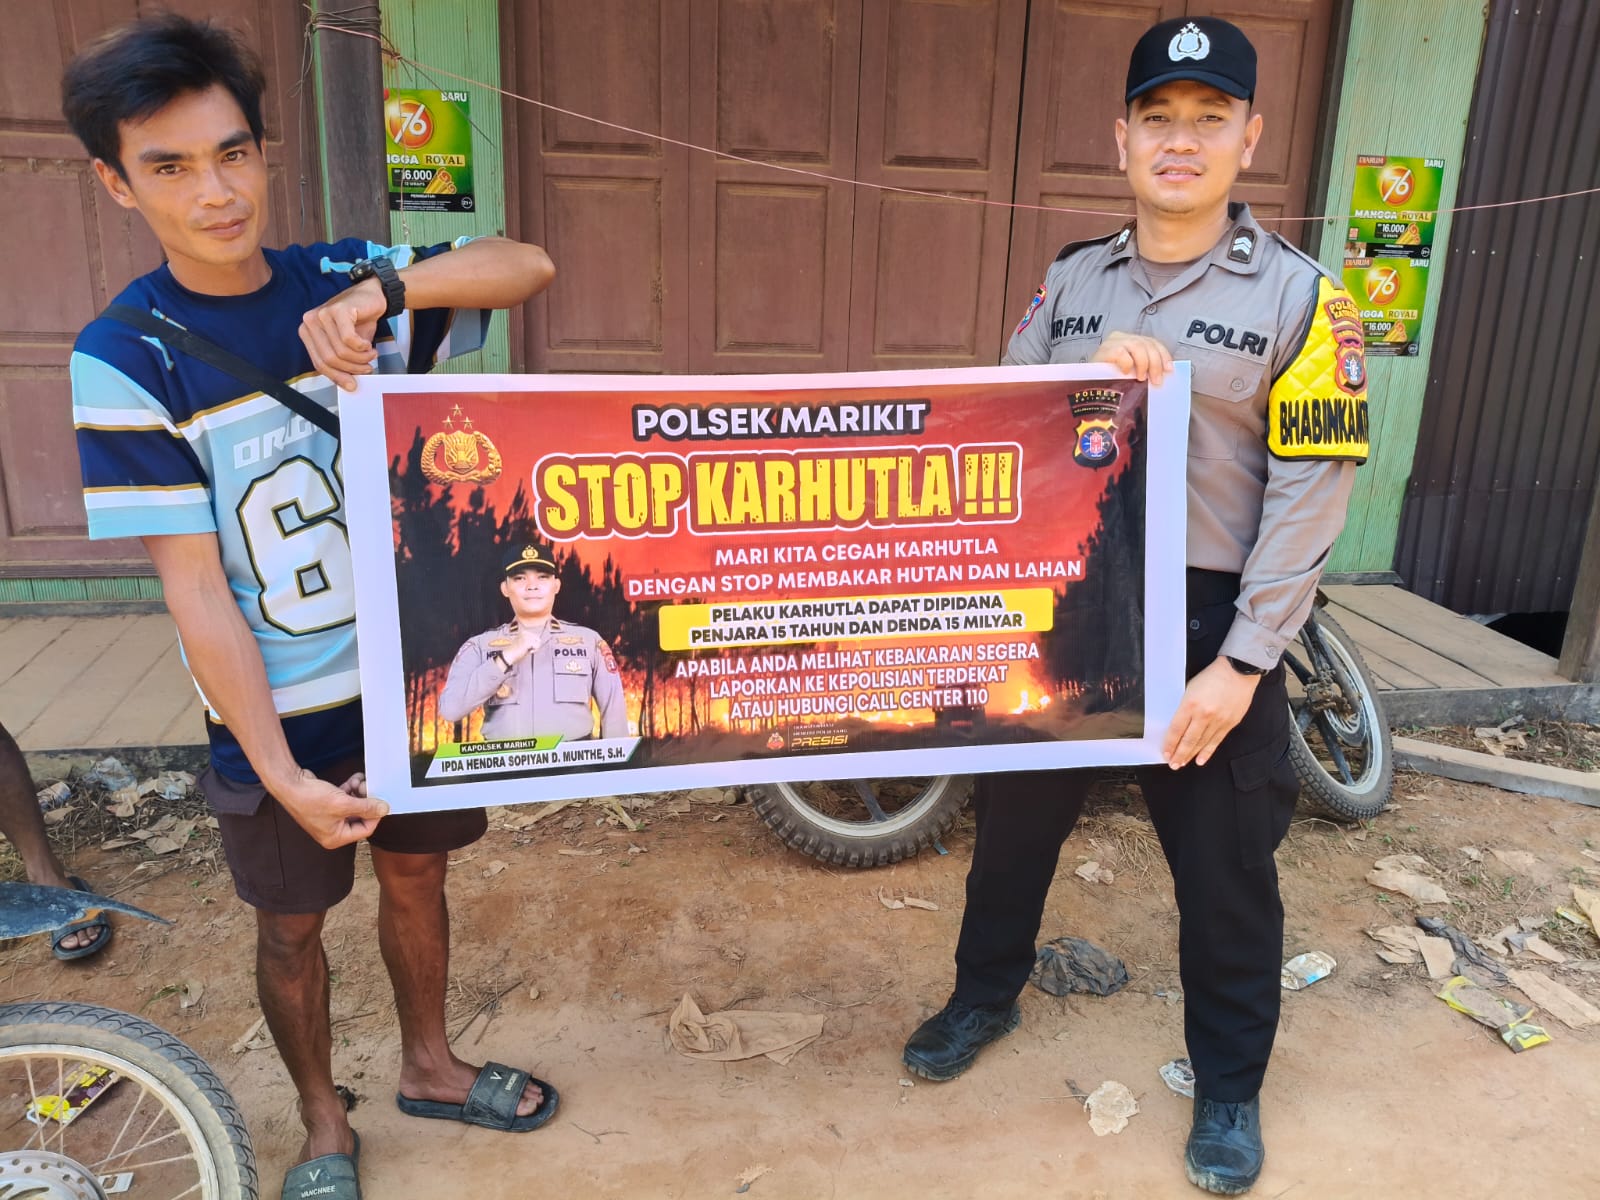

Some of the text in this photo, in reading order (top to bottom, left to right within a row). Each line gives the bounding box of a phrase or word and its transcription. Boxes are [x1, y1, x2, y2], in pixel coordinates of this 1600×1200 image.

[425, 155, 463, 165] ROYAL
[1355, 210, 1430, 221] MANGGA ROYAL
[1382, 224, 1405, 233] 16.000
[1051, 315, 1102, 340] IRFAN
[1186, 319, 1268, 357] POLRI
[1075, 390, 1117, 398] POLRES
[637, 405, 925, 436] POLSEK MARIKIT
[543, 452, 1012, 531] STOP KARHUTLA !!!
[235, 454, 356, 637] 6
[715, 538, 998, 566] MARI KITA CEGAH KARHUTLA
[628, 560, 1081, 596] DENGAN STOP MEMBAKAR HUTAN DAN LAHAN
[712, 595, 1002, 622] PELAKU KARHUTLA DAPAT DIPIDANA
[691, 613, 1022, 643] PENJARA 15 TAHUN DAN DENDA 15 MILYAR
[554, 649, 587, 657] POLRI
[675, 643, 1039, 678] APABILA ANDA MELIHAT KEBAKARAN SEGERA
[710, 665, 1008, 698] LAPORKAN KE KEPOLISIAN TERDEKAT
[731, 689, 988, 719] ATAU HUBUNGI CALL CENTER 110
[461, 740, 535, 753] KAPOLSEK MARIKIT
[791, 735, 848, 748] PRESISI
[441, 747, 625, 773] IPDA HENDRA SOPIYAN D. MUNTHE, S.H.
